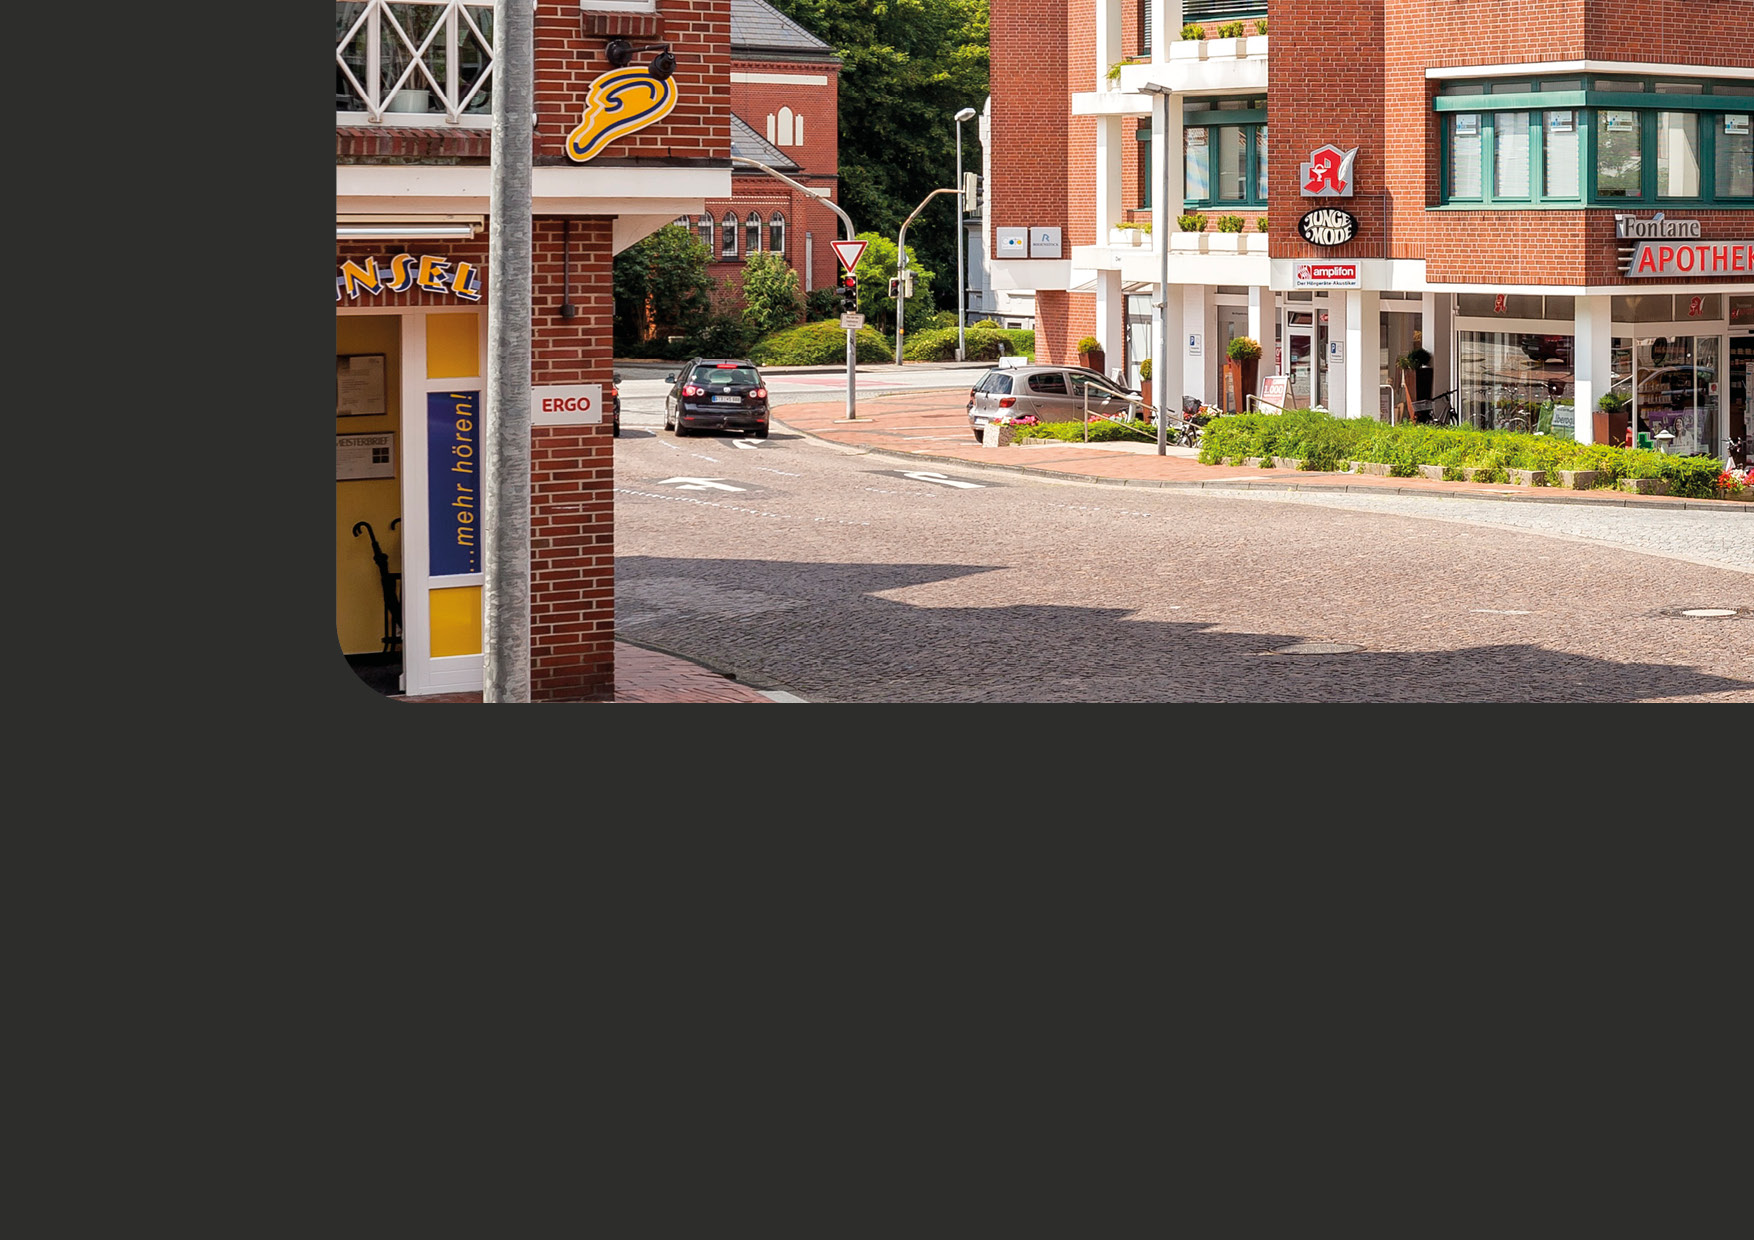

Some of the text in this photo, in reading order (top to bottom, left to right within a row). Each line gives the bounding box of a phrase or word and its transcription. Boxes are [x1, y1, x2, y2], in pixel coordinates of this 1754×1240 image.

[1303, 209, 1352, 231] JUNGE
[1624, 216, 1700, 237] Fontane
[1304, 225, 1352, 245] MODE
[336, 253, 482, 301] NSEL
[1313, 266, 1354, 278] amplifon
[542, 397, 591, 413] ERGO
[450, 393, 474, 474] hören!
